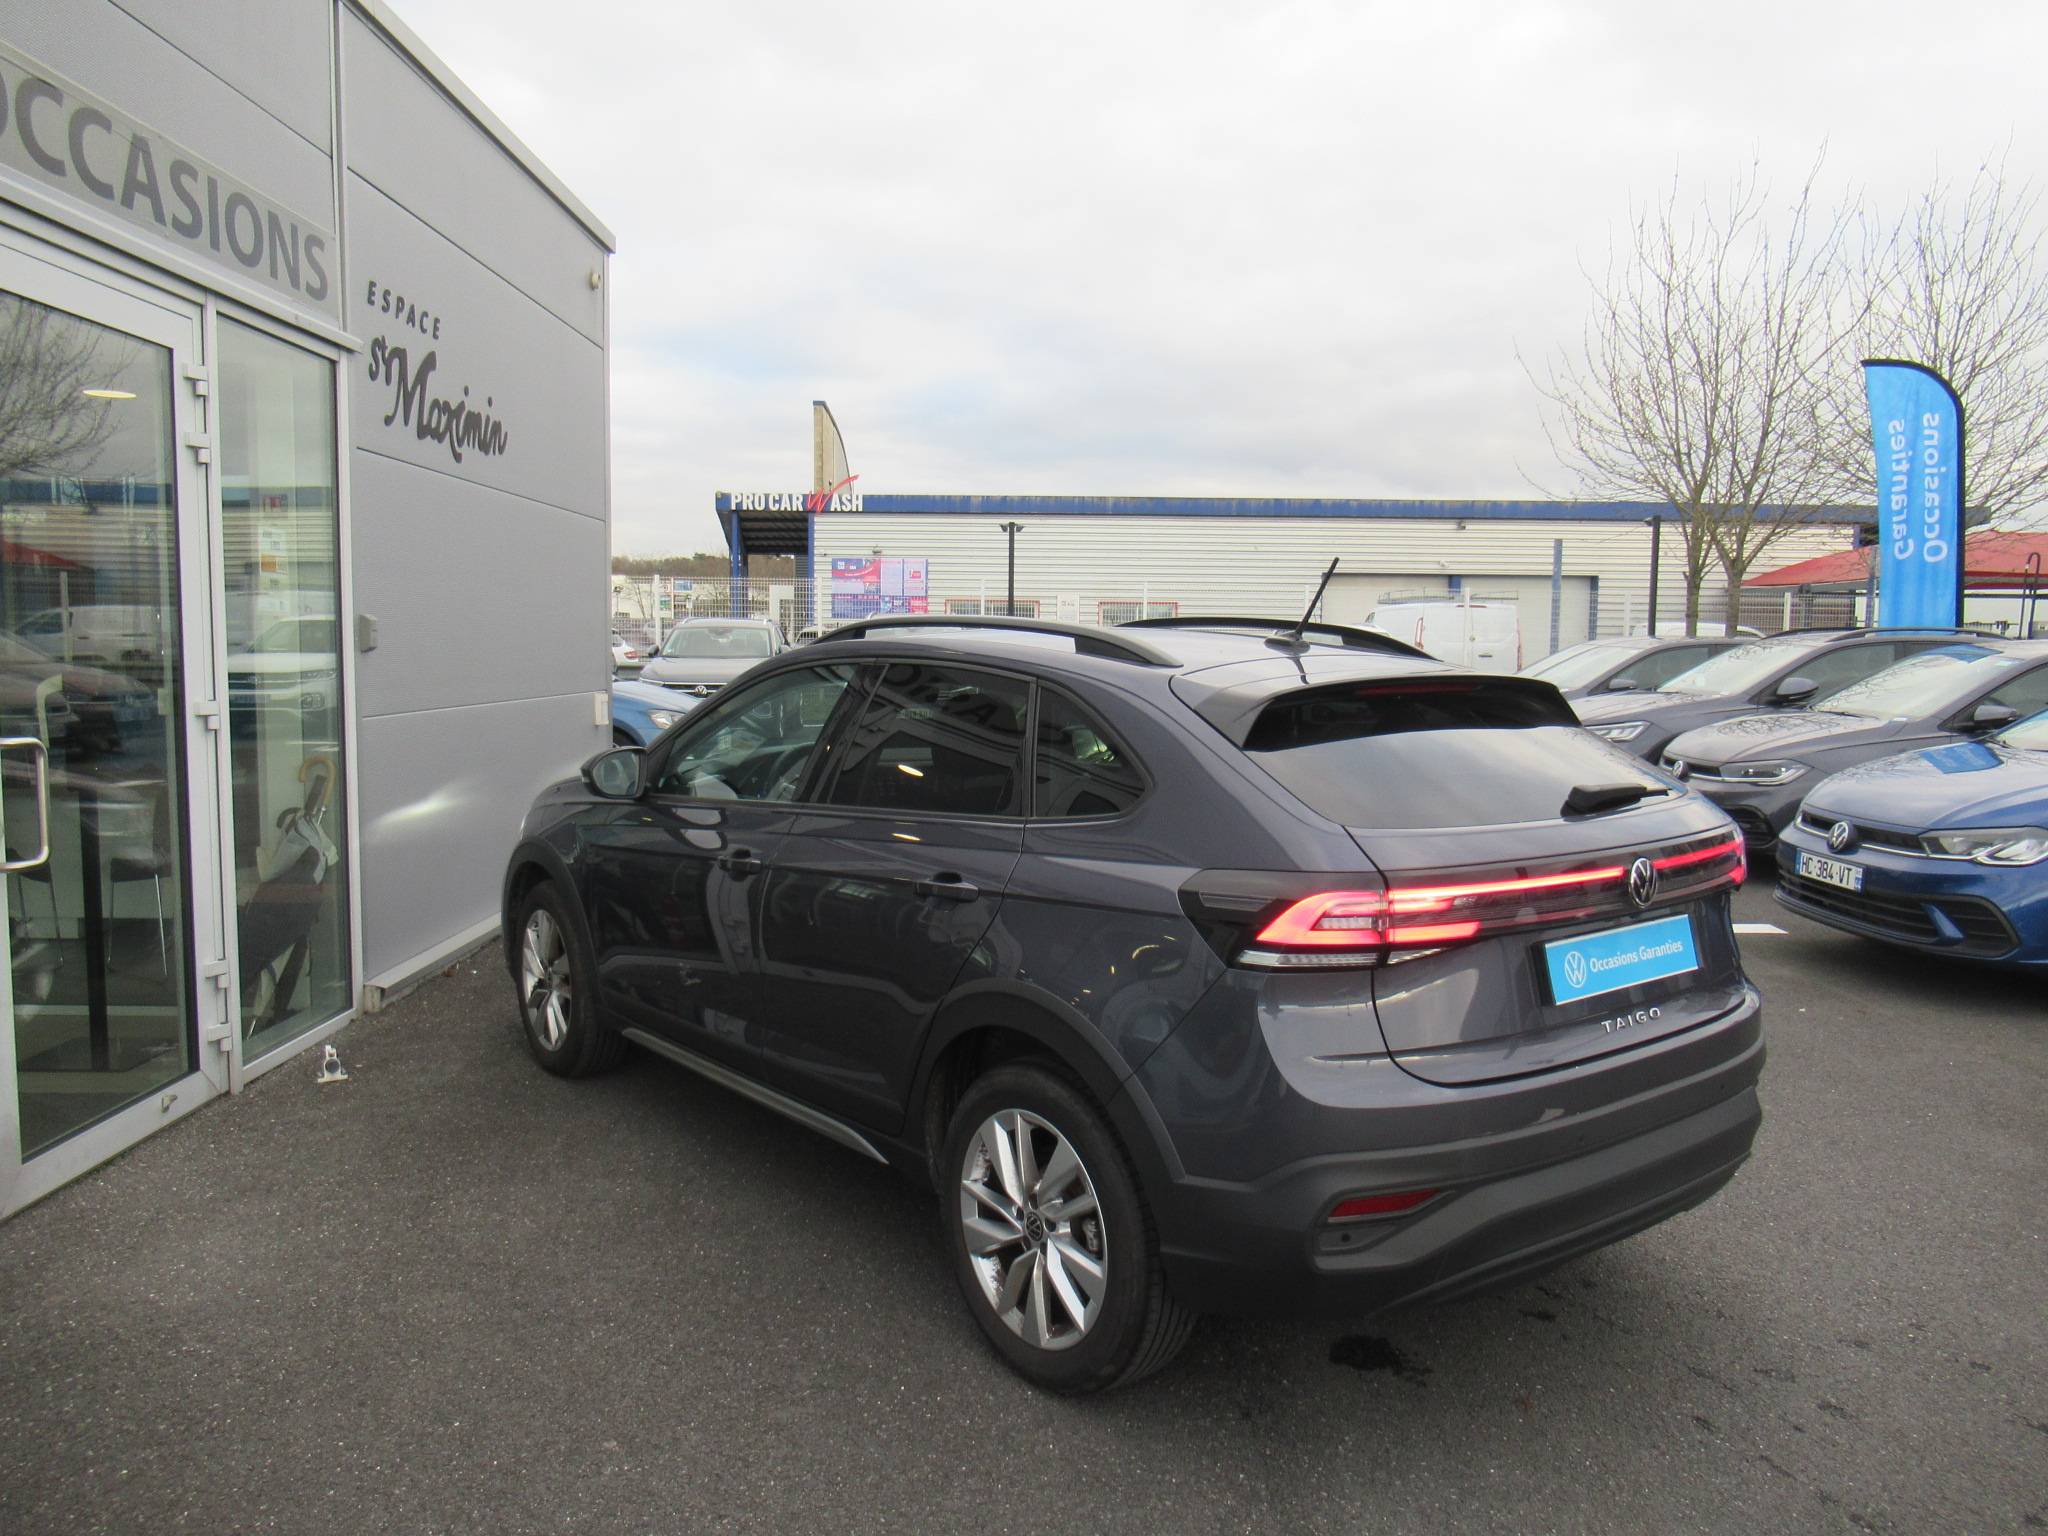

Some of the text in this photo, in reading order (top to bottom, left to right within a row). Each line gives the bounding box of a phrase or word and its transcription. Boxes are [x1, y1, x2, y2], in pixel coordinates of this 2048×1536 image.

[0, 72, 328, 301] CCASIONS
[368, 280, 440, 340] ESPACE
[384, 347, 508, 464] Maximin
[731, 475, 863, 515] PRO CAR WASH
[1590, 951, 1638, 973] Occasions
[1639, 939, 1683, 960] Garanties
[1601, 1007, 1661, 1033] TAIGO
